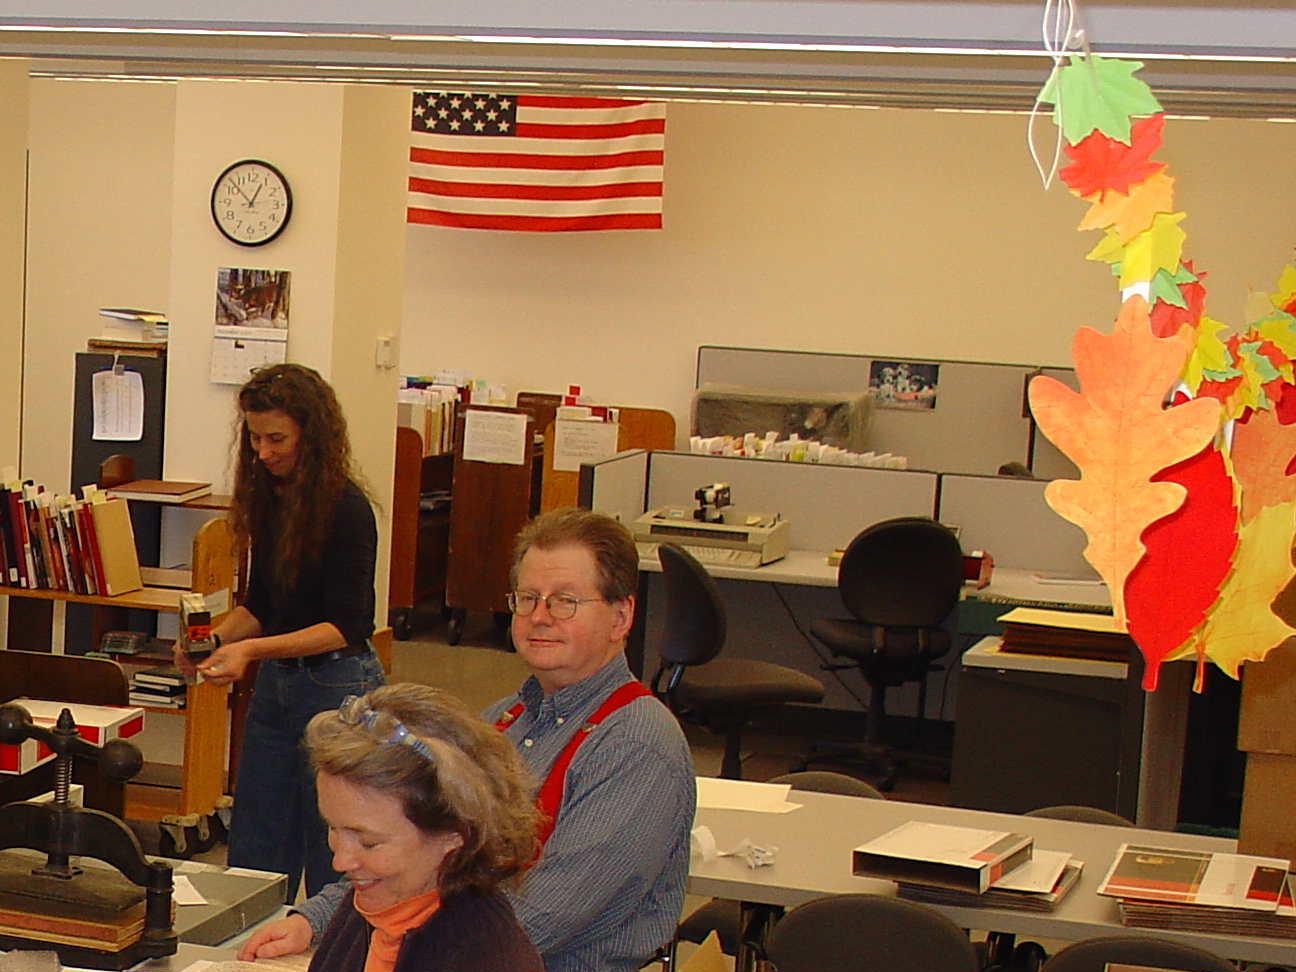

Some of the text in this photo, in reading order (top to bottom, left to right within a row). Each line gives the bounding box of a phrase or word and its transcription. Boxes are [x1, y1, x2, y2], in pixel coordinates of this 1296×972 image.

[237, 176, 246, 186] 11
[247, 173, 259, 183] 12
[264, 177, 268, 187] 1
[227, 185, 240, 196] 10
[269, 187, 277, 197] 2
[223, 198, 232, 207] 9
[272, 200, 280, 210] 3
[226, 210, 235, 220] 8
[268, 213, 276, 222] 4
[235, 220, 243, 229] 7
[259, 221, 267, 231] 5
[246, 225, 255, 235] 6
